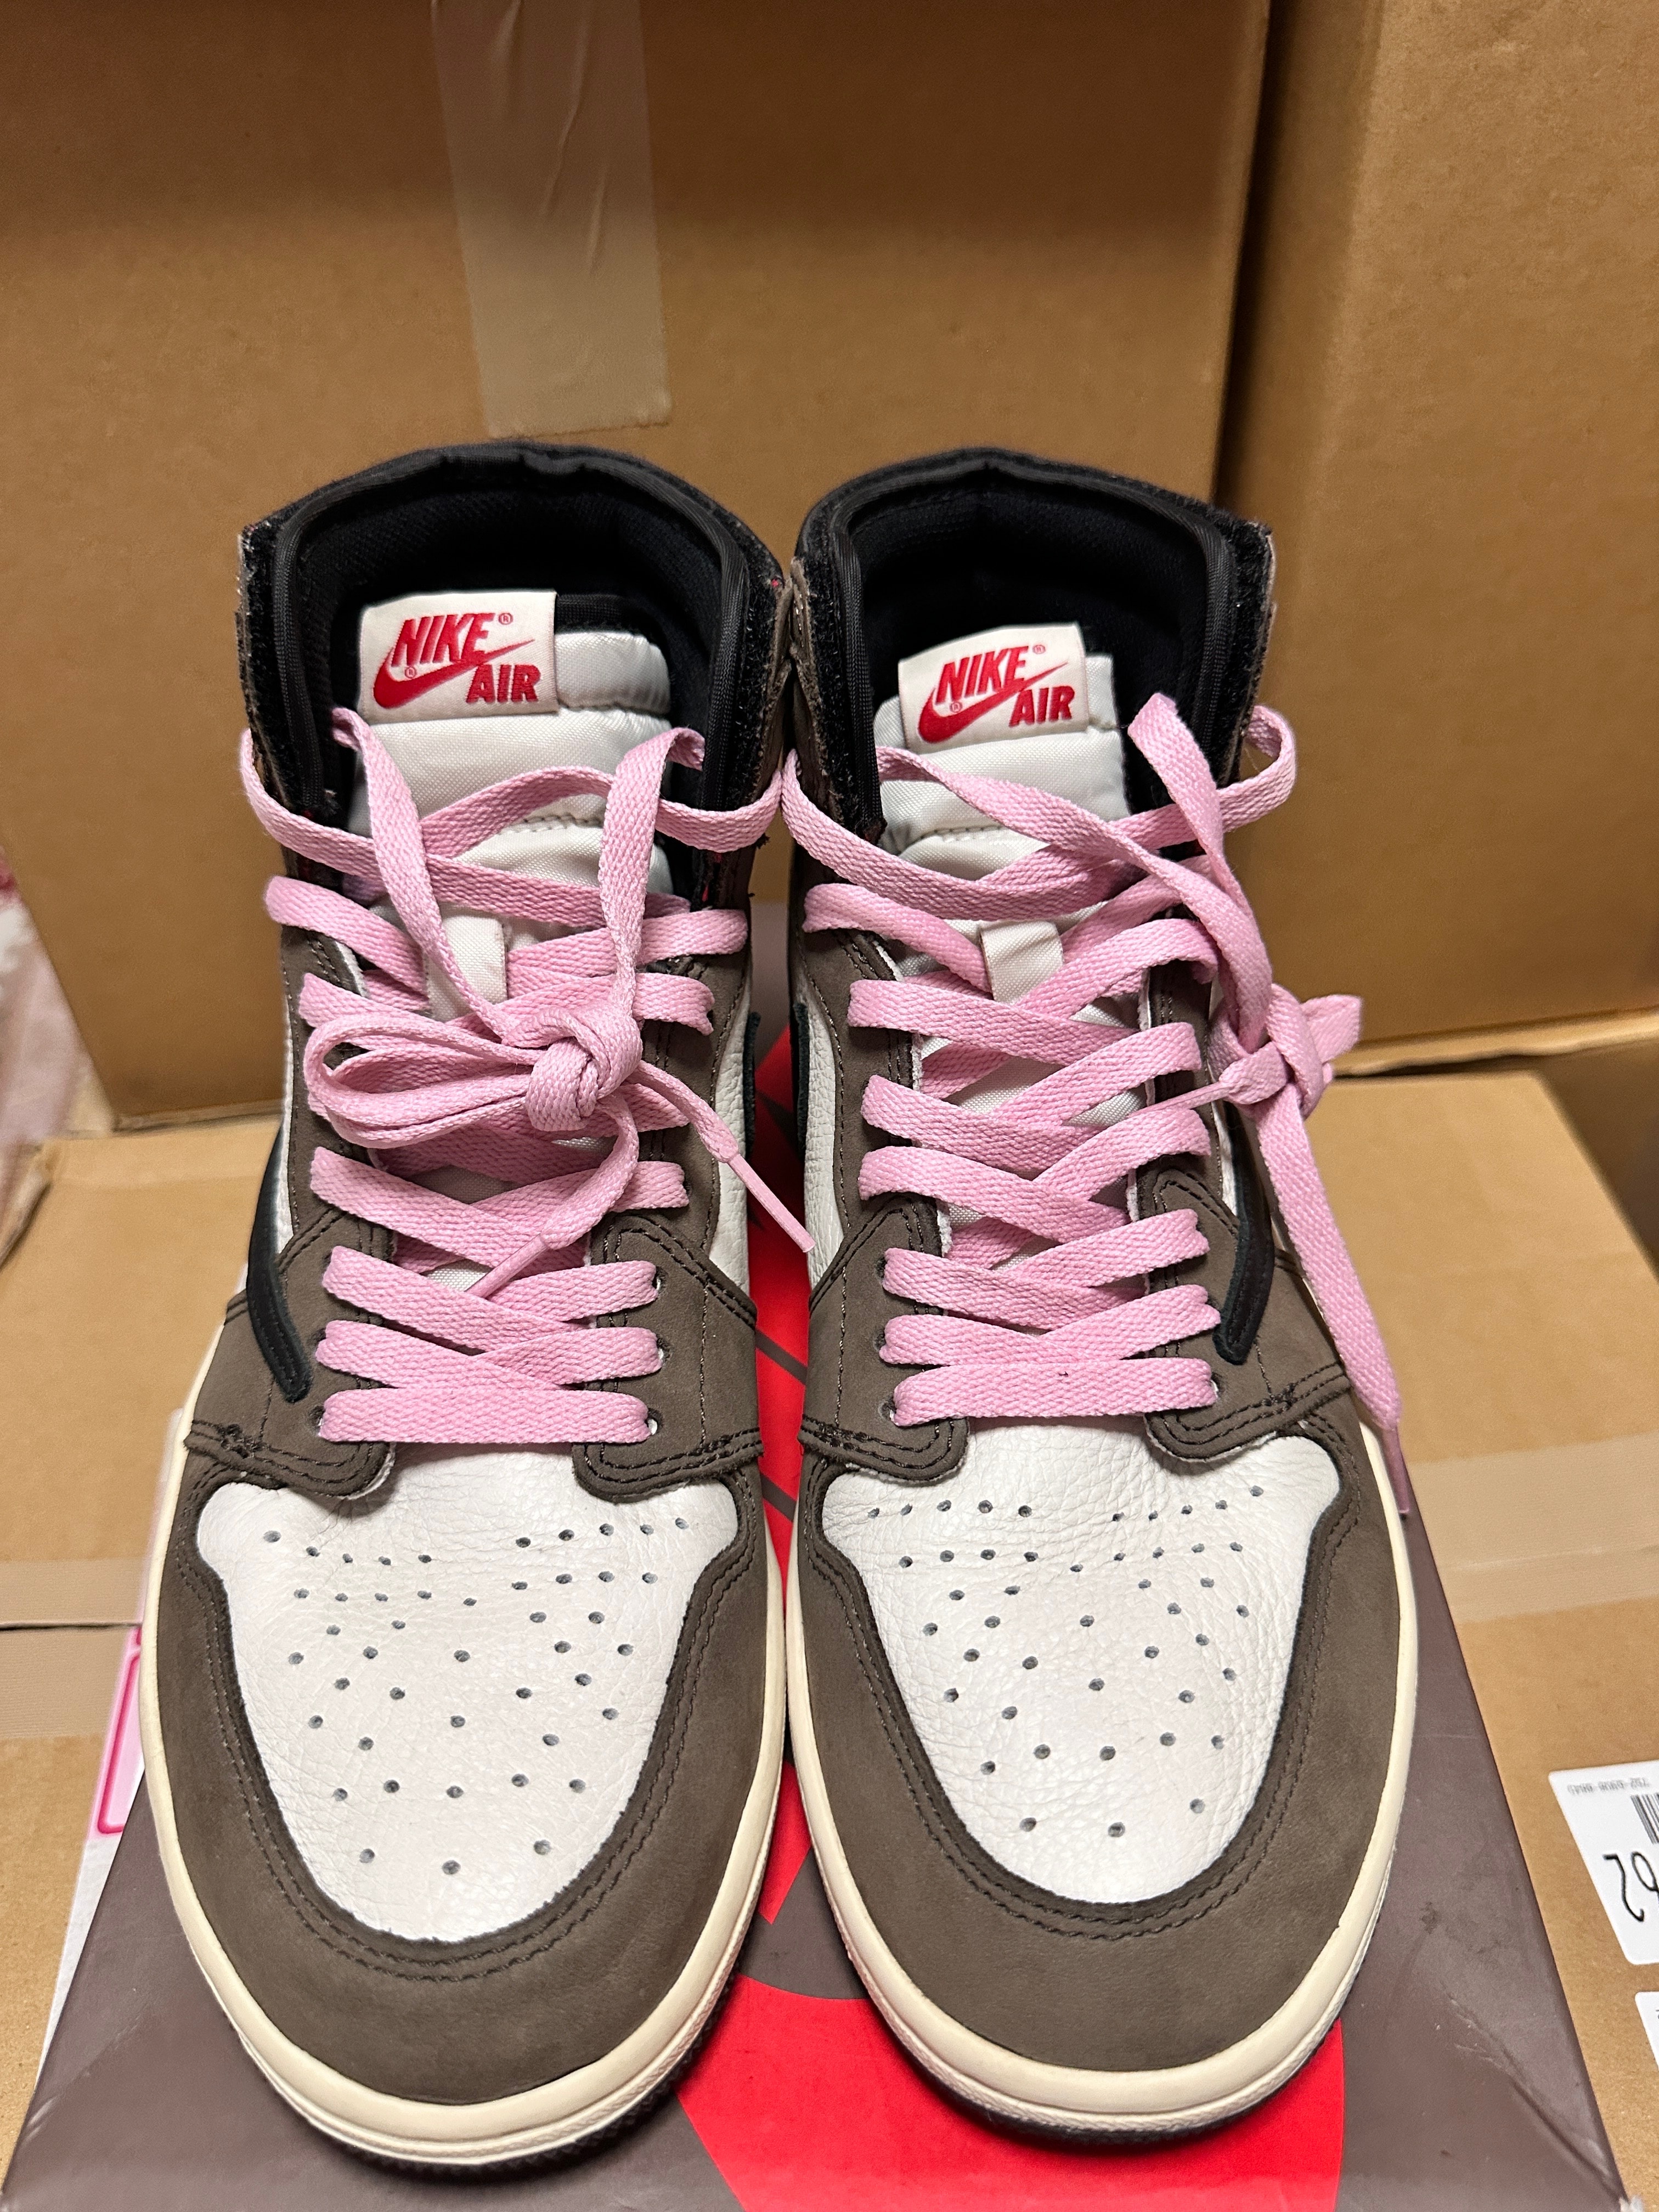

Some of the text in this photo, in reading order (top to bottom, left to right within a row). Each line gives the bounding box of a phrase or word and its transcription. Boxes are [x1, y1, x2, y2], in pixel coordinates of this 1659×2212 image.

[391, 612, 496, 668] NIKE
[466, 664, 541, 704] AIR
[935, 645, 1029, 705] NIKE
[1008, 685, 1075, 727] AIR
